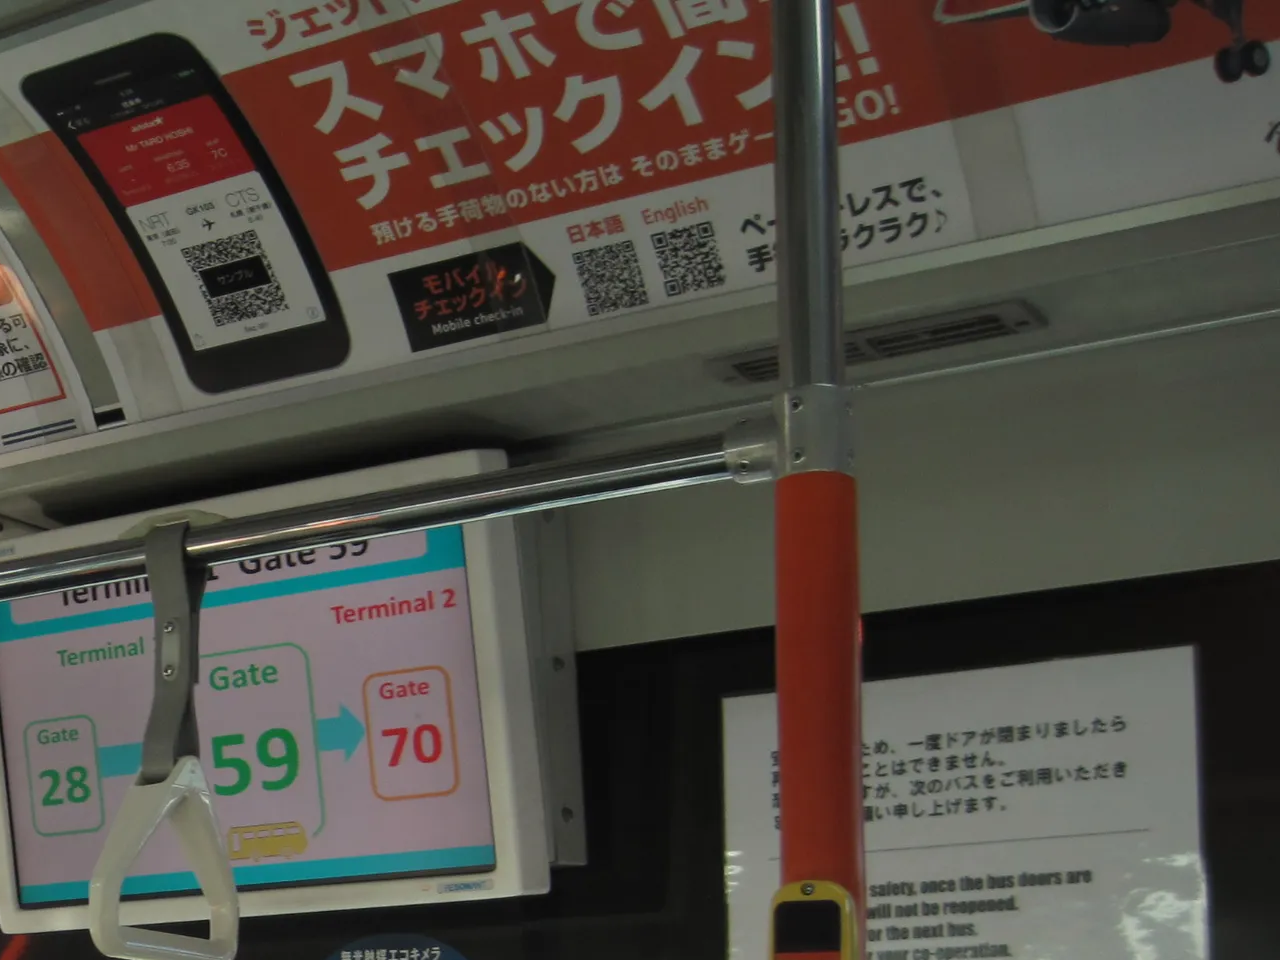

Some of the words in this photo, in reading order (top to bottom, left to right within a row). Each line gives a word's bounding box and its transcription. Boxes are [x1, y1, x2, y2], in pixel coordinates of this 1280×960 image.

[224, 187, 261, 208] CTS
[370, 163, 623, 246] 預ける手荷物のない方は
[631, 127, 775, 177] そのままゲー
[138, 211, 170, 232] NRT
[641, 196, 710, 227] English
[740, 177, 943, 236] ペレスで、
[566, 213, 625, 244] 日本語
[431, 316, 472, 336] Mobile
[473, 305, 525, 326] check-in
[61, 576, 150, 607] Termin
[331, 590, 435, 625] Terminal
[442, 588, 457, 608] 2
[56, 635, 145, 668] Terminal
[209, 663, 279, 691] Gate
[378, 680, 430, 700] Gate
[37, 726, 80, 746] Gate
[380, 722, 443, 768] 70
[211, 726, 301, 797] 59
[38, 765, 91, 807] 28
[869, 880, 917, 900] safety,
[920, 878, 957, 895] once
[959, 875, 984, 893] the
[986, 872, 1015, 890] bus
[1018, 870, 1063, 889] doors
[1066, 868, 1092, 884] are
[894, 900, 918, 917] not
[919, 898, 940, 916] be
[942, 895, 1019, 917] reopened.
[888, 924, 910, 940] the
[913, 921, 945, 939] next
[947, 919, 979, 937] bus.
